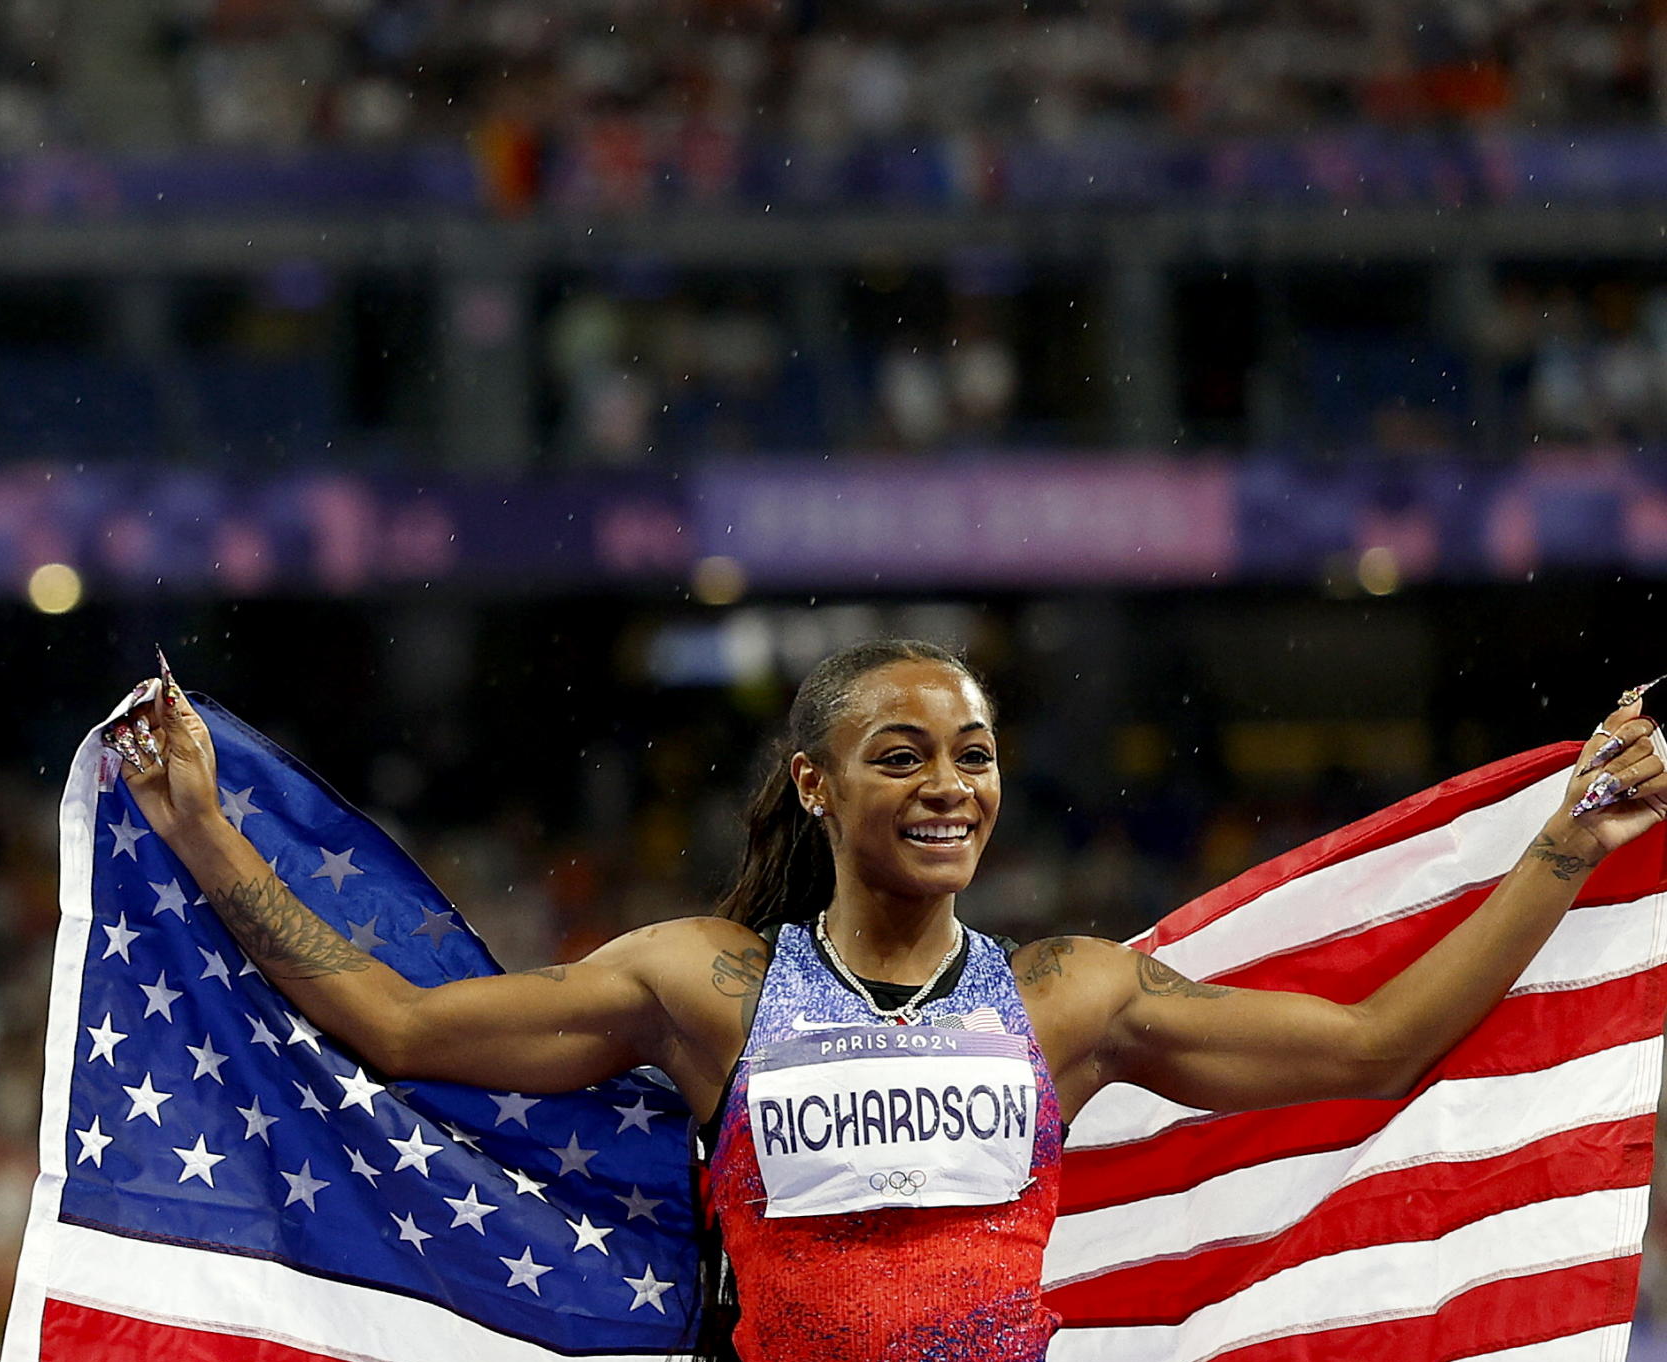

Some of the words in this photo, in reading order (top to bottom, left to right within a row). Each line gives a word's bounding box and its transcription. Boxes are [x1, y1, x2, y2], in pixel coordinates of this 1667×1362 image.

[821, 1034, 888, 1055] PARIS
[895, 1033, 957, 1051] 2024
[759, 1084, 1027, 1156] RICHARDSON
